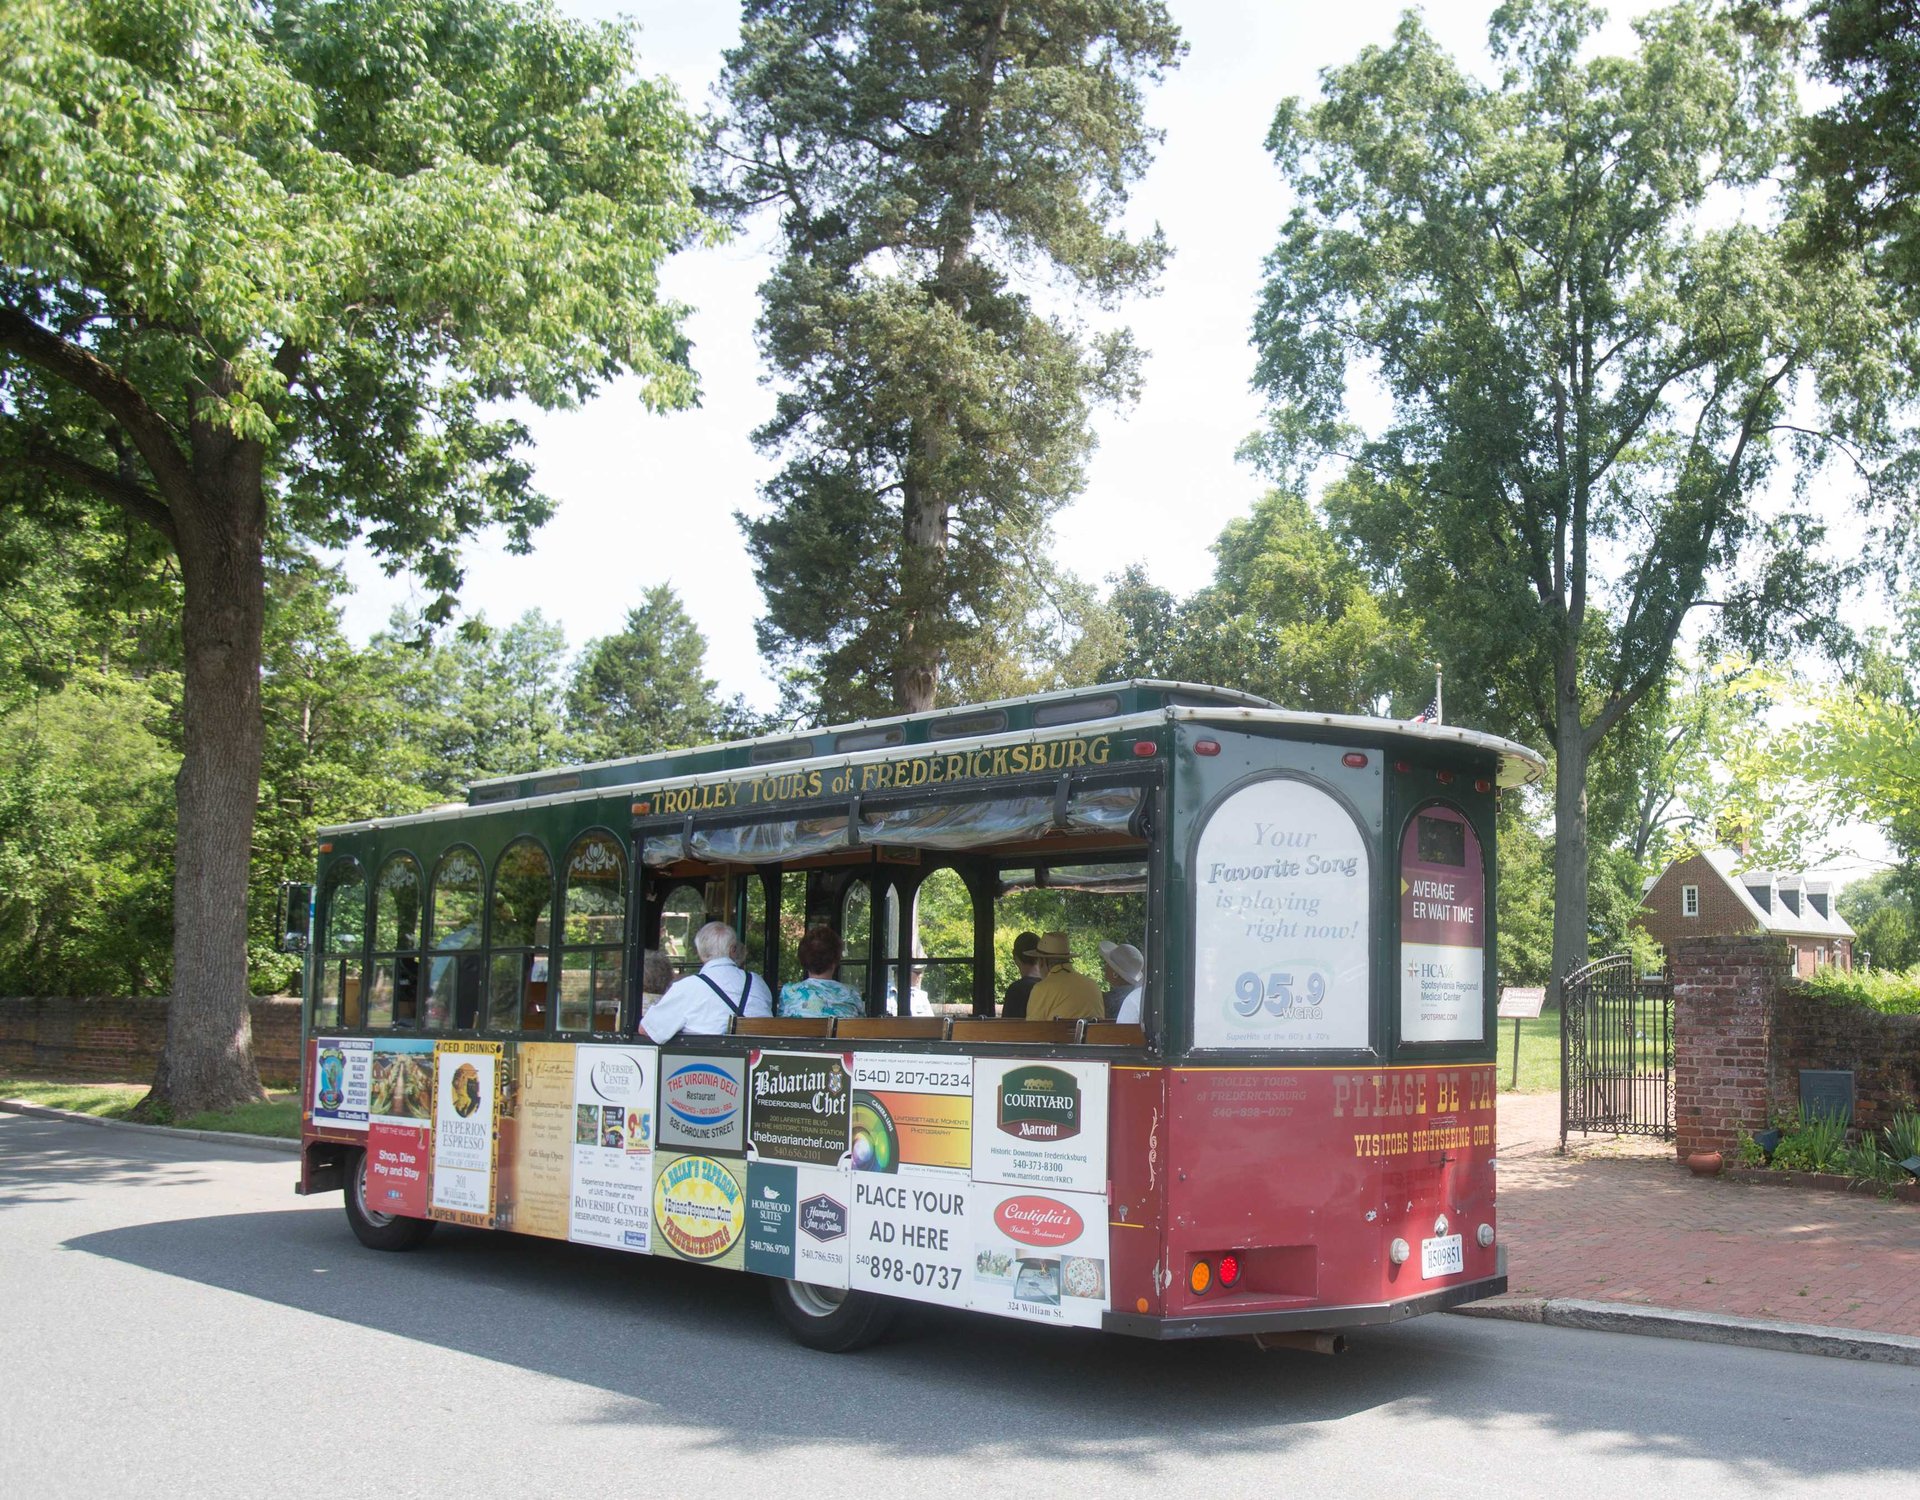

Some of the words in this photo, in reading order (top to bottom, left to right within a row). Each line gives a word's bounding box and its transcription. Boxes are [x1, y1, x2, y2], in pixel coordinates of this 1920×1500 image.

[652, 781, 740, 814] TROLLEY
[749, 770, 823, 803] TOURS
[832, 768, 853, 795] of
[860, 735, 1111, 791] FREDERICKSBURG
[1253, 822, 1318, 849] Your
[1208, 858, 1301, 884] Favorite
[1304, 854, 1359, 877] Song
[1413, 879, 1455, 901] AVERAGE
[1215, 889, 1233, 909] is
[1237, 890, 1321, 917] playing
[1413, 901, 1426, 919] ER
[1427, 903, 1451, 921] WAIT
[1452, 905, 1474, 924] TIME
[1245, 918, 1299, 943] right
[1304, 920, 1360, 940] now!
[1232, 970, 1326, 1018] 95.9
[1420, 980, 1456, 991] Spotsylvania
[1456, 981, 1479, 992] Regional
[1420, 992, 1443, 1001] Medical
[1443, 992, 1462, 1001] Center
[1282, 1006, 1323, 1021] WGRQ
[464, 1043, 496, 1053] DRINKS
[769, 1064, 780, 1072] THE
[667, 1076, 683, 1093] THE
[684, 1073, 719, 1088] VIRGINIA
[719, 1078, 738, 1098] DELI
[754, 1067, 827, 1100] Bavarian
[854, 1069, 891, 1084] (540)
[895, 1071, 970, 1087] 207-0234
[1210, 1076, 1259, 1087] TROLLEY
[1262, 1076, 1299, 1087] TOURS
[492, 1059, 501, 1128] MOCHA
[686, 1091, 716, 1101] Restaurant
[1004, 1093, 1074, 1110] COURTYARD
[1210, 1090, 1308, 1101] FREDERICKSBURG
[1332, 1073, 1427, 1117] PLEASE
[1437, 1072, 1460, 1113] BE
[1469, 1071, 1497, 1110] PA
[757, 1098, 812, 1110] FREDERICKSBURG
[812, 1091, 847, 1118] Chef
[871, 1099, 887, 1119] CAMERA
[442, 1119, 487, 1136] HYPERION
[669, 1116, 681, 1131] 826
[680, 1124, 711, 1139] CAROLINE
[711, 1120, 735, 1138] STREET
[780, 1116, 812, 1125] LAFAYETTE
[812, 1118, 829, 1127] BLVD
[894, 1115, 940, 1124] UNFORGETTABLE
[940, 1118, 969, 1126] MOMENTS
[1019, 1122, 1058, 1136] Marriott
[399, 1129, 416, 1137] VILLAGE
[773, 1123, 801, 1132] HISTORIC
[801, 1126, 819, 1134] TRAIN
[819, 1128, 845, 1137] STATION
[910, 1127, 952, 1136] PHOTOGRAPHY
[443, 1134, 485, 1151] ESPRESSO
[753, 1130, 845, 1151] thebavarianchef.com
[1354, 1131, 1409, 1157] VISITORS
[1412, 1126, 1470, 1152] SIGHTSEEING
[1473, 1124, 1490, 1147] OUR
[378, 1149, 399, 1163] Shop,
[400, 1152, 416, 1164] Dine
[529, 1148, 538, 1158] Gift
[538, 1149, 550, 1161] Shop
[550, 1151, 564, 1162] Open
[774, 1145, 821, 1160] 540.656.2101
[990, 1147, 1012, 1156] Historic
[1013, 1149, 1043, 1158] Downtown
[1044, 1151, 1087, 1163] Fredericksburg
[374, 1162, 389, 1176] Play
[389, 1167, 403, 1177] and
[403, 1167, 420, 1181] Stay
[1013, 1159, 1063, 1172] 540-373-8300
[490, 1143, 499, 1213] LATTE
[444, 1187, 468, 1200] William
[613, 1183, 643, 1191] enchantment
[751, 1199, 791, 1213] HOMEWOOD
[856, 1183, 907, 1209] PLACE
[912, 1190, 964, 1216] YOUR
[434, 1208, 456, 1221] OPEN
[460, 1212, 485, 1226] DAILY
[760, 1210, 782, 1221] SUITES
[806, 1206, 839, 1222] Hampton
[1004, 1203, 1071, 1226] Castiglia's
[804, 1218, 819, 1229] Inn
[825, 1220, 842, 1233] Suites
[1010, 1224, 1030, 1235] Italian
[1032, 1227, 1066, 1239] Restaurant
[869, 1220, 896, 1243] AD
[902, 1224, 949, 1251] HERE
[750, 1240, 790, 1255] 540.786.9700
[801, 1248, 843, 1264] 540.786.5530
[1427, 1246, 1461, 1269] H509851
[856, 1254, 870, 1265] 540
[870, 1255, 962, 1291] 898-0737
[1007, 1301, 1020, 1311] 324
[1022, 1303, 1051, 1317] William
[1053, 1308, 1065, 1318] St.
